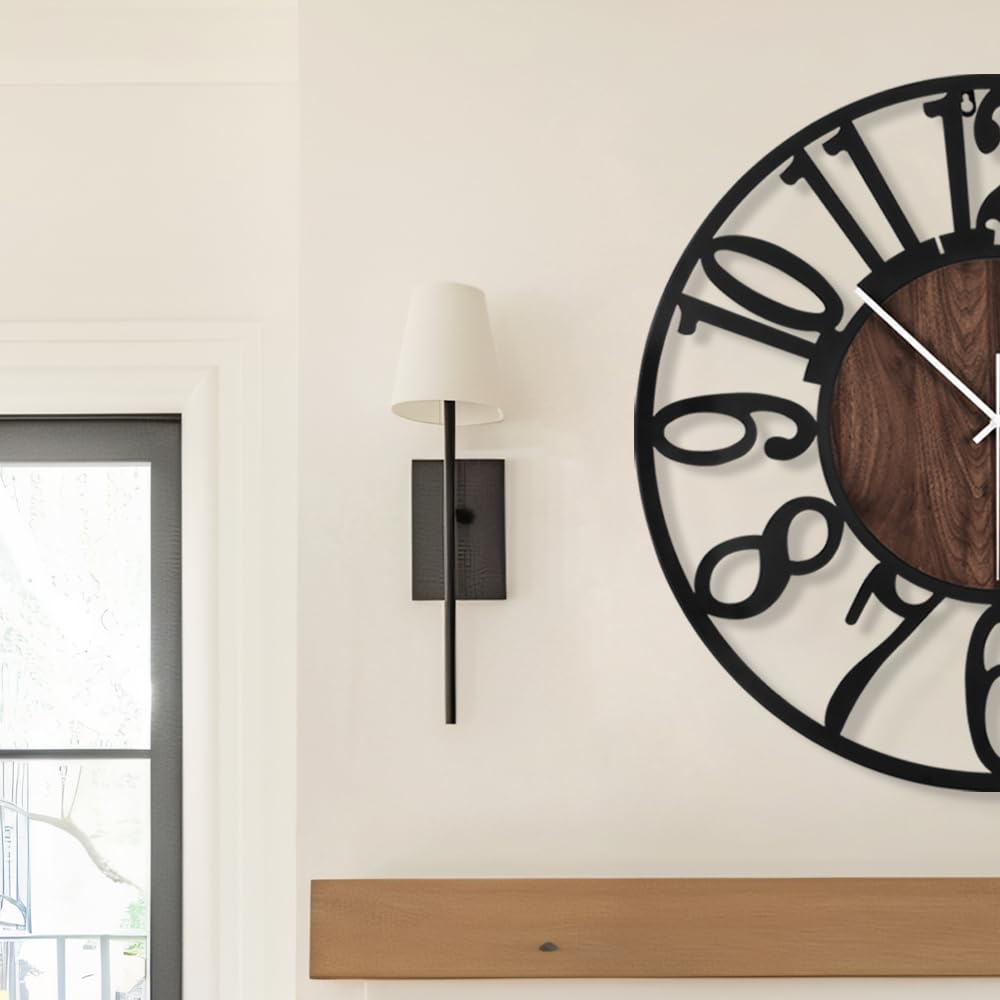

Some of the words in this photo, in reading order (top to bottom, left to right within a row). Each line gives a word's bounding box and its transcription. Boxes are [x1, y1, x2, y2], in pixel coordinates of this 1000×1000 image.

[780, 118, 941, 290] 11
[678, 234, 846, 385] 10
[651, 391, 819, 467] 9
[694, 496, 845, 621] 8
[825, 560, 946, 737] 7
